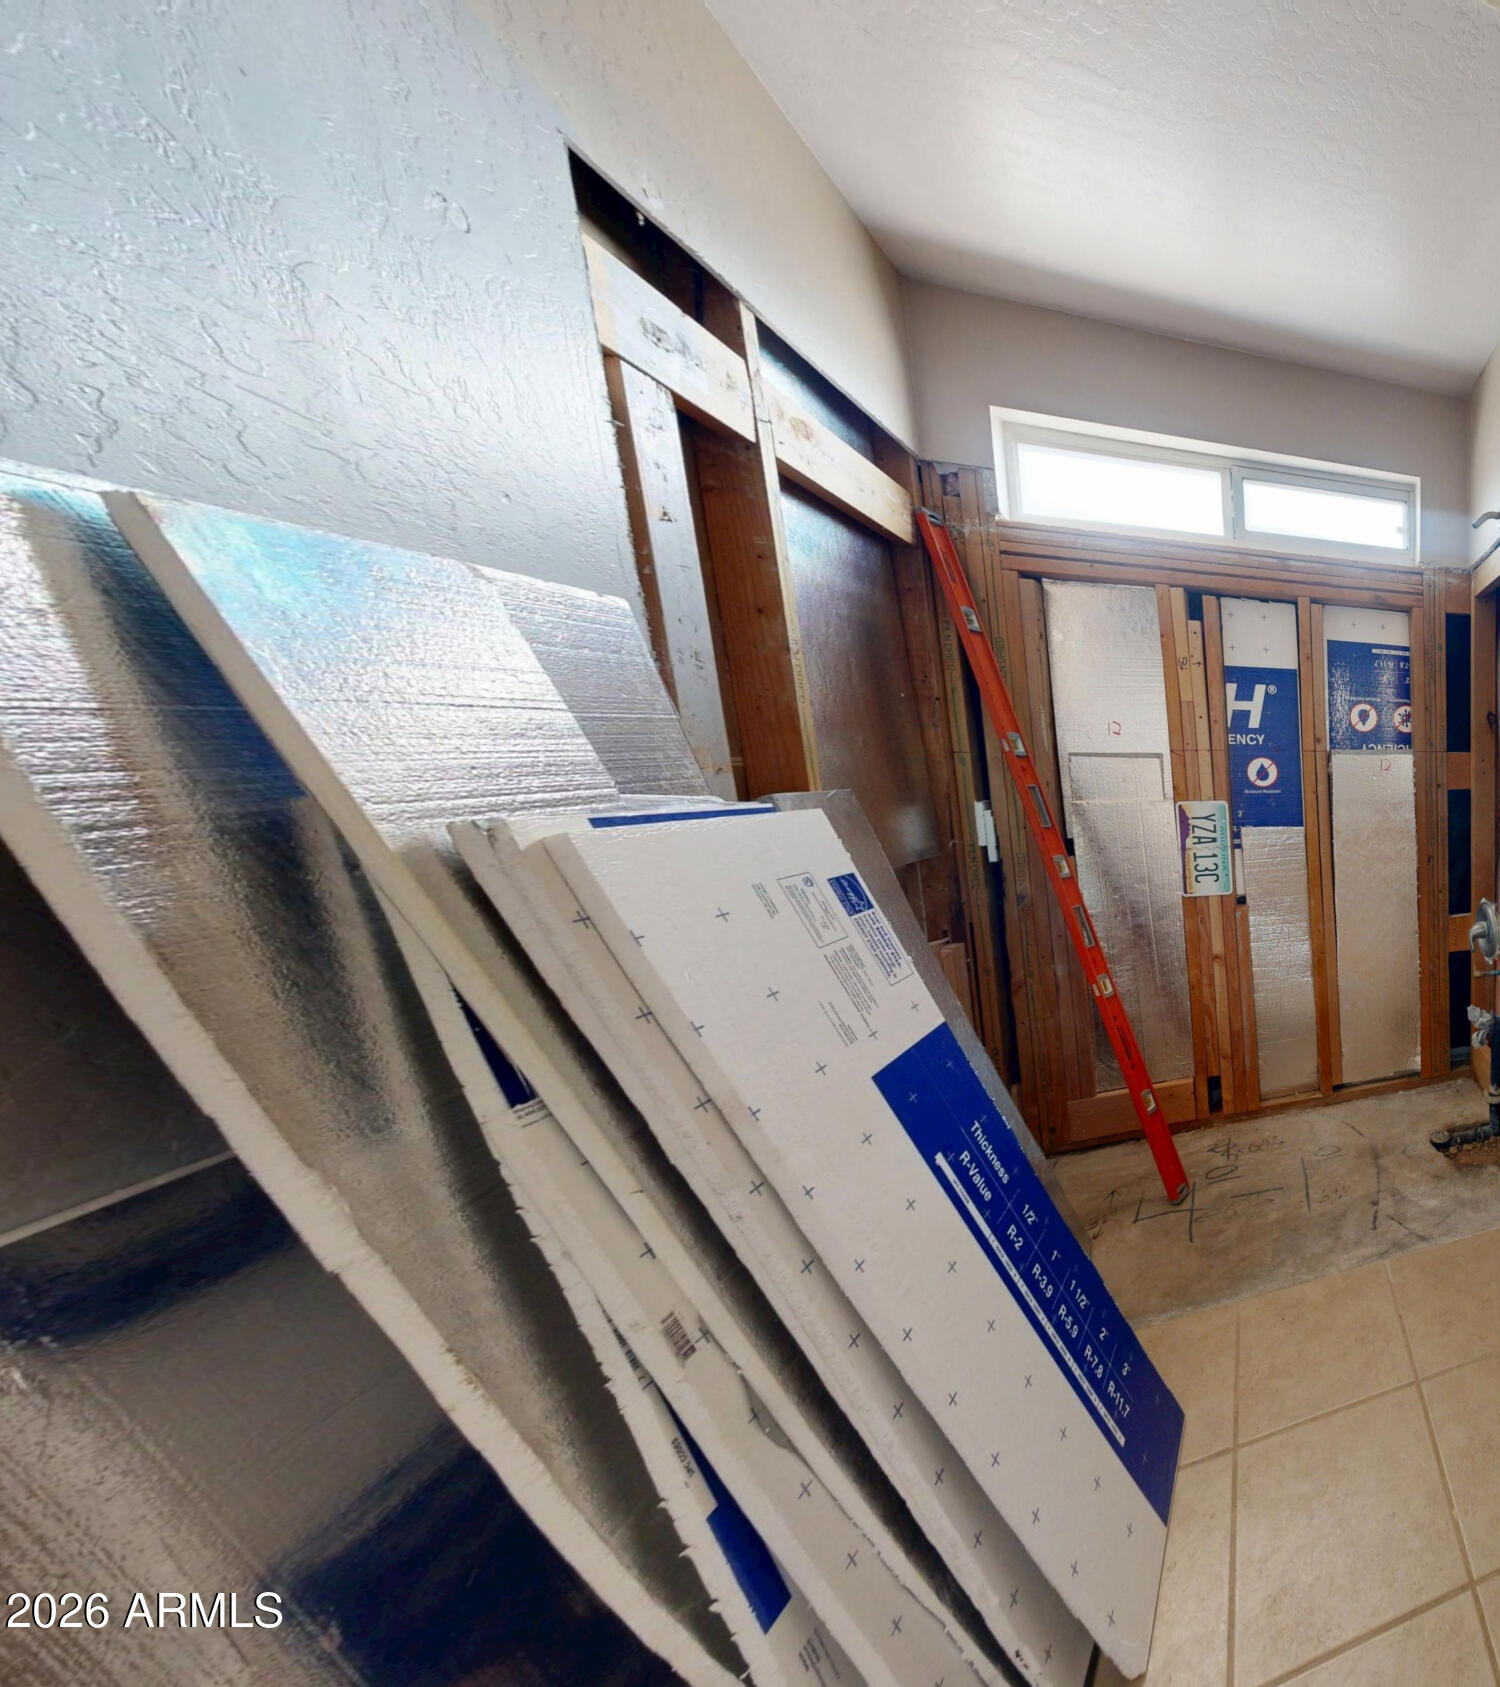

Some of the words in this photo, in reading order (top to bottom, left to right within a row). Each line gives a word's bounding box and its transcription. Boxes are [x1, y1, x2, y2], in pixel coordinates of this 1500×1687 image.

[1228, 734, 1265, 745] ENCY
[1191, 814, 1218, 845] YZA
[1193, 852, 1220, 884] 13C
[970, 1120, 1010, 1184] Thickness
[960, 1150, 992, 1202] R-Value
[1006, 1224, 1024, 1251] R-2
[1031, 1263, 1054, 1298] R-3.9
[1058, 1304, 1079, 1339] R-5.9
[1084, 1344, 1104, 1379] R-7.8
[1107, 1380, 1130, 1418] R-11.7
